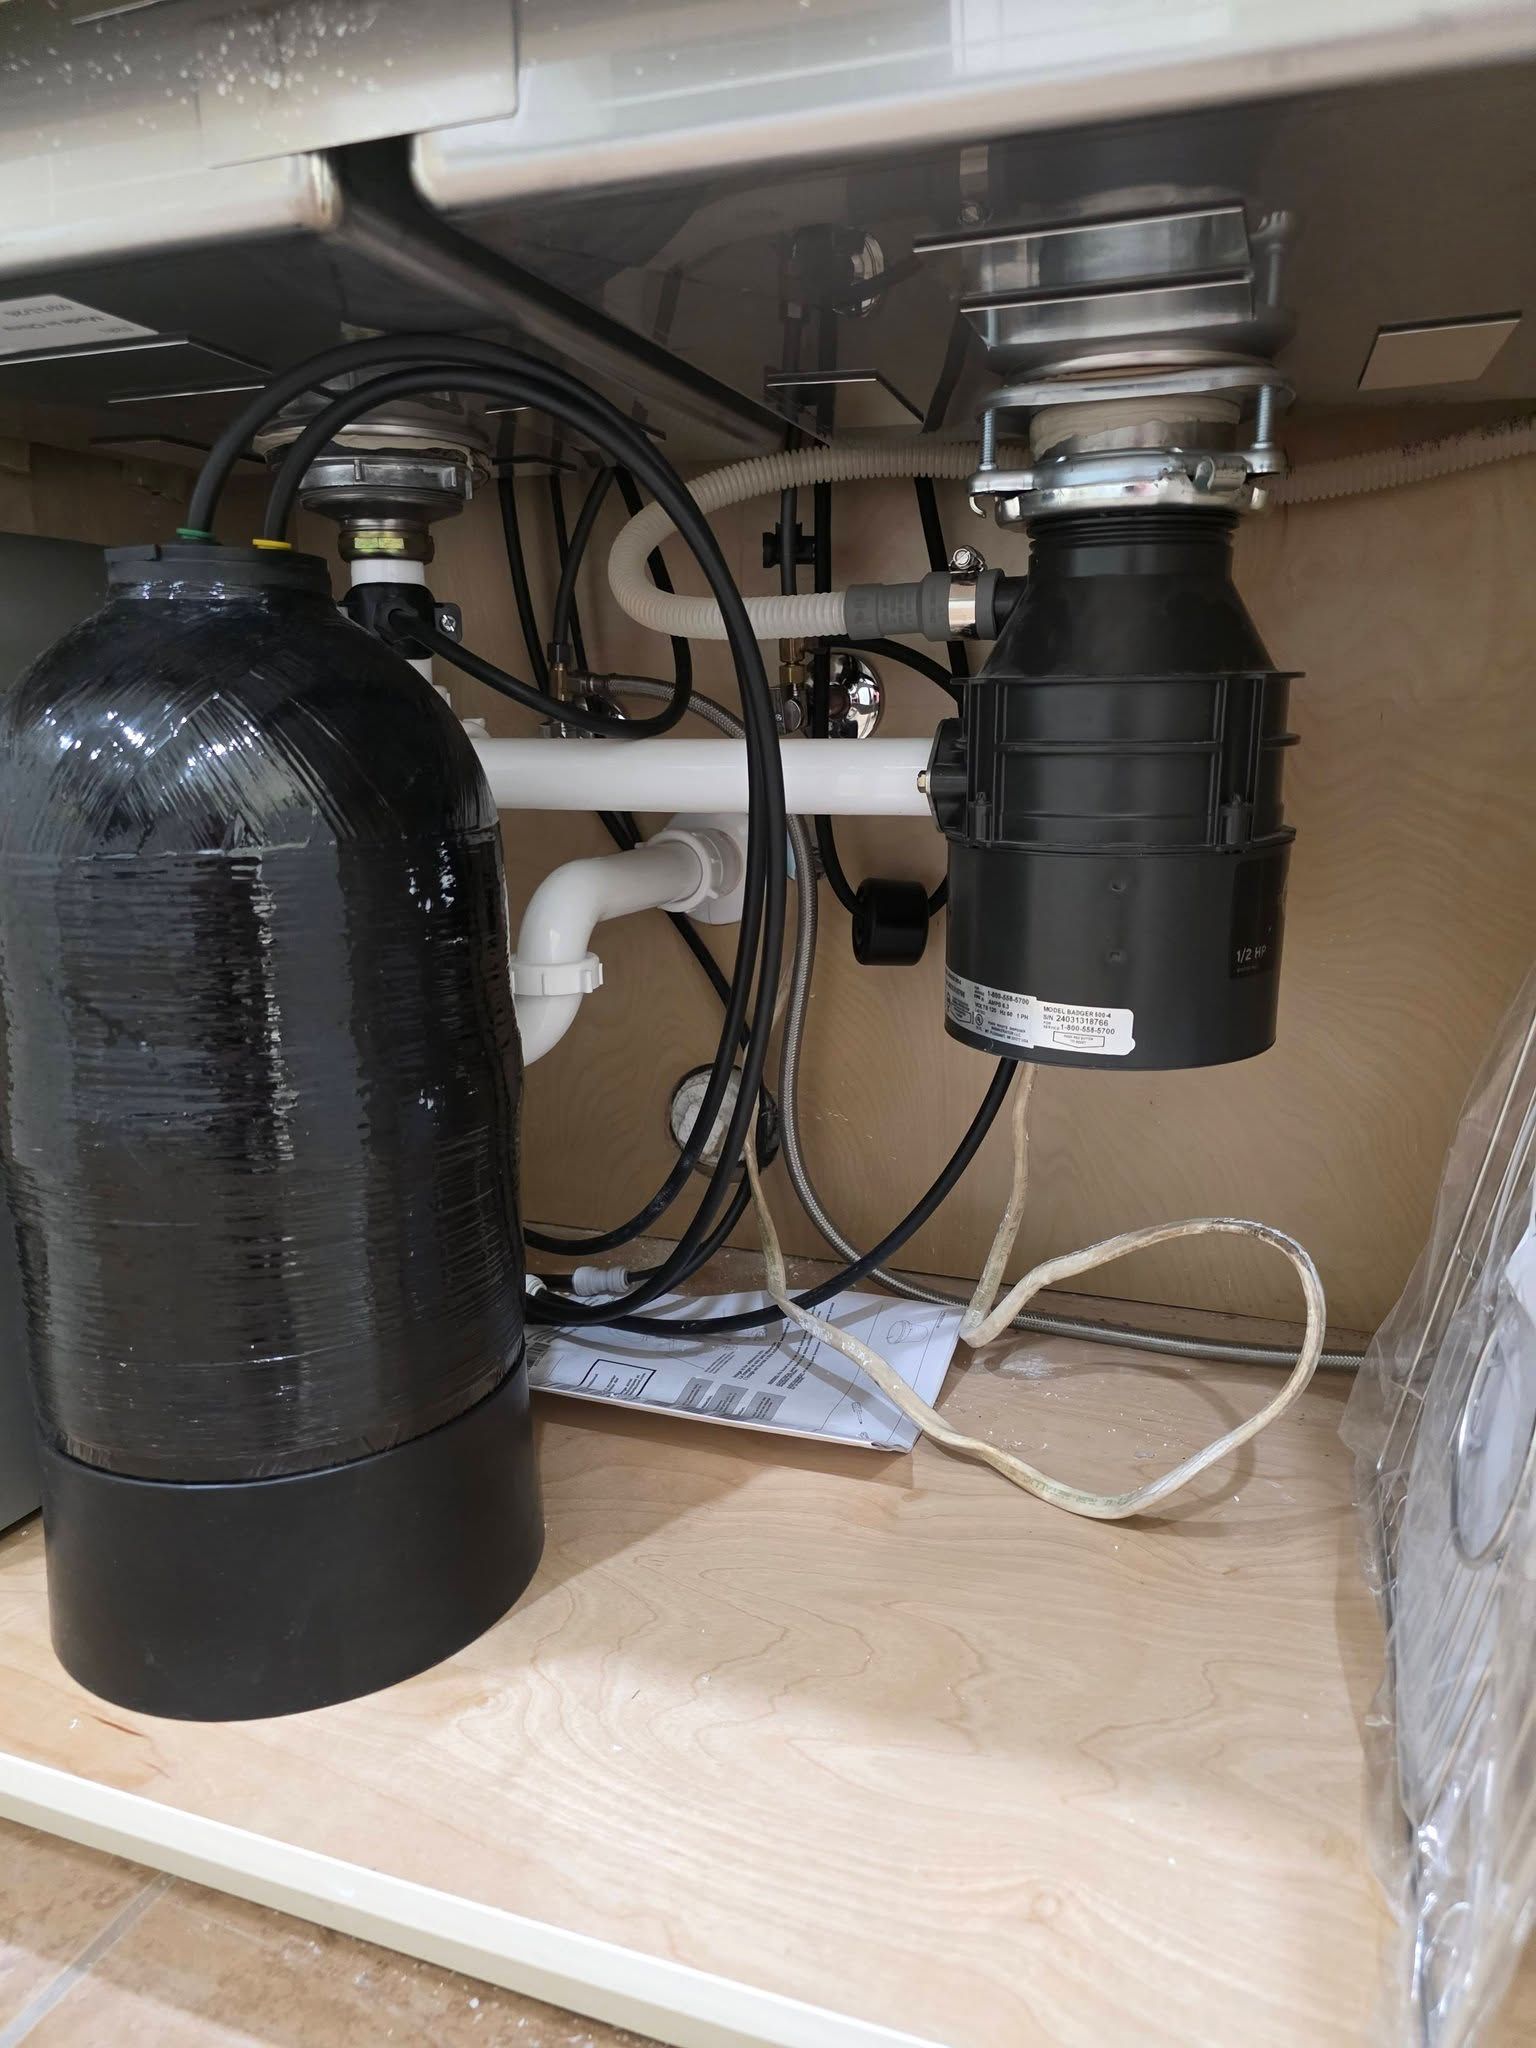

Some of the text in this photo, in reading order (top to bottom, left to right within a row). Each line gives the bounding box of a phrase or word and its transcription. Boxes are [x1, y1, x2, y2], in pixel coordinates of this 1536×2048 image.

[1236, 944, 1267, 964] 1/2 HP
[987, 990, 1030, 1005] 1-800-558-5700
[988, 999, 1002, 1008] AMPS
[1043, 1006, 1066, 1014] MODEL
[1067, 1009, 1094, 1017] BADGER
[1056, 1015, 1109, 1027] 24031318766
[1060, 1024, 1116, 1035] 1-800-558-5700
